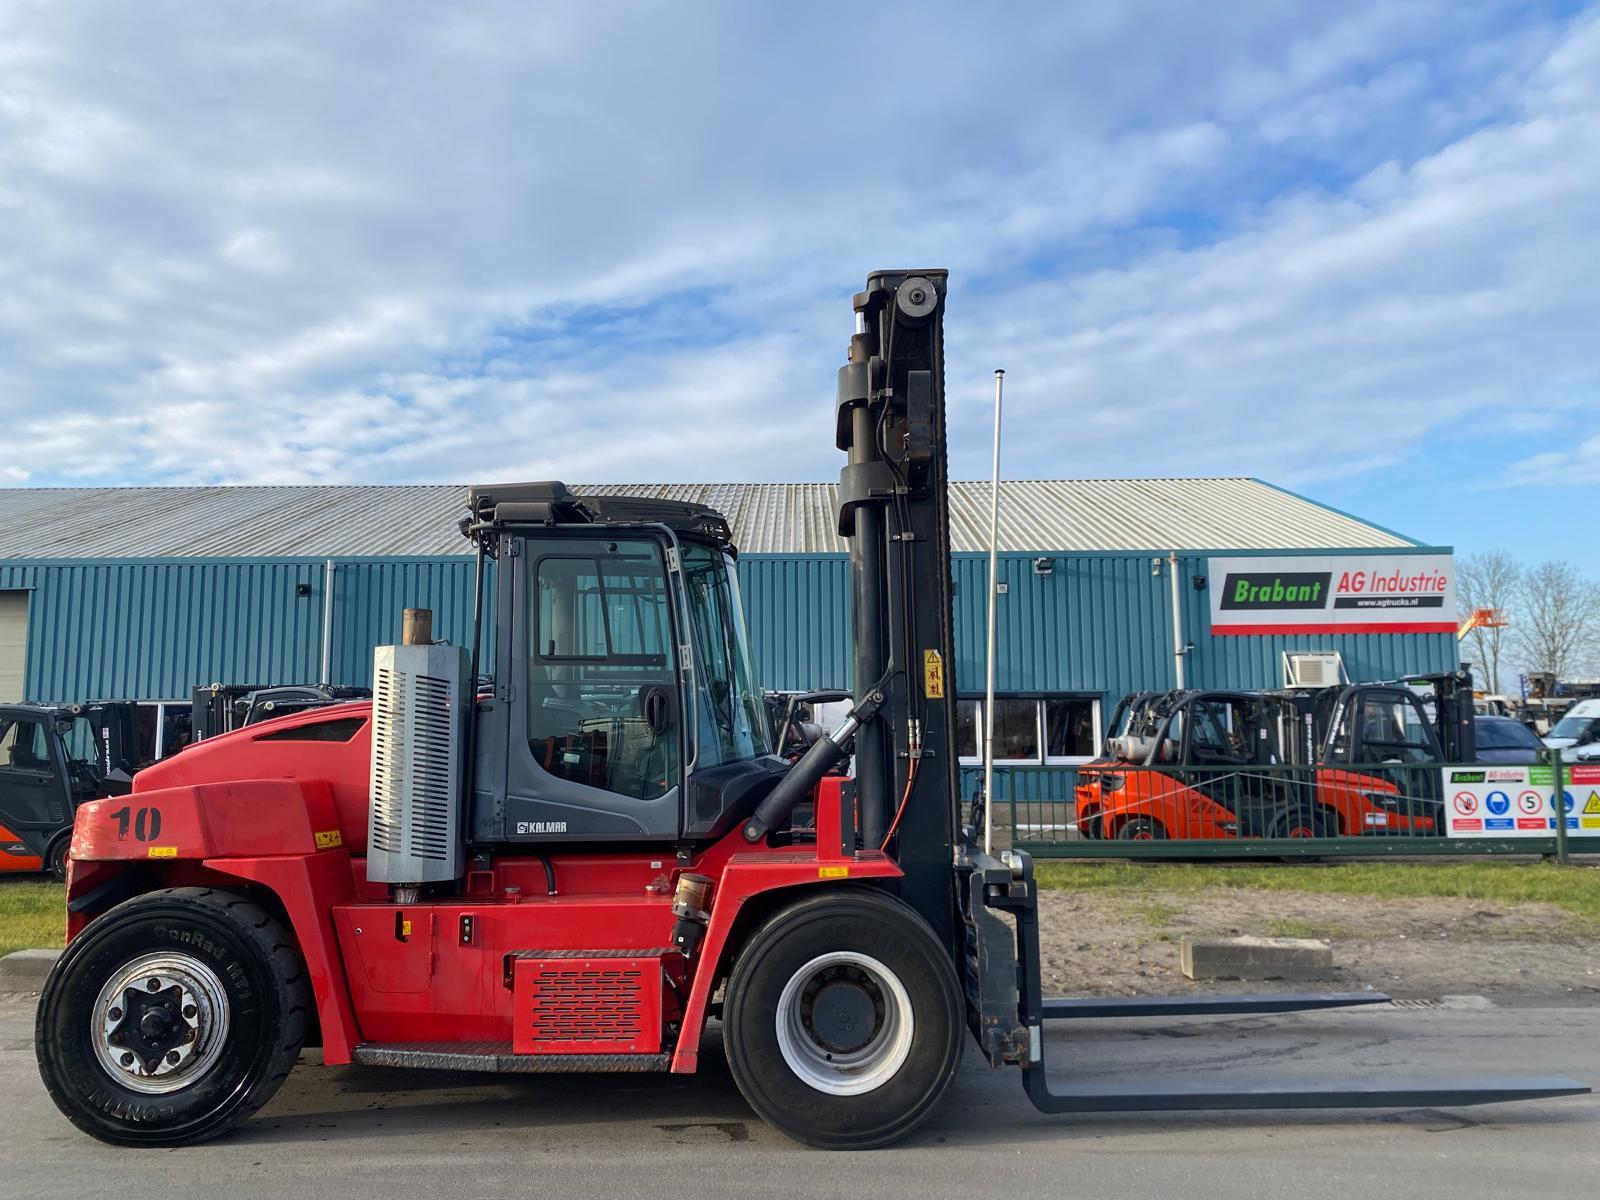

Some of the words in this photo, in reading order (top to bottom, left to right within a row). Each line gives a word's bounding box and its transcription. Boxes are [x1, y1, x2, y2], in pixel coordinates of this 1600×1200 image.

[1337, 571, 1366, 593] AG
[1370, 569, 1447, 593] Industrie
[1234, 579, 1321, 603] Brabant
[1357, 598, 1419, 608] www.agtrucks.nl
[1526, 796, 1535, 809] 5
[110, 806, 162, 842] 10
[529, 822, 567, 833] KALMAR
